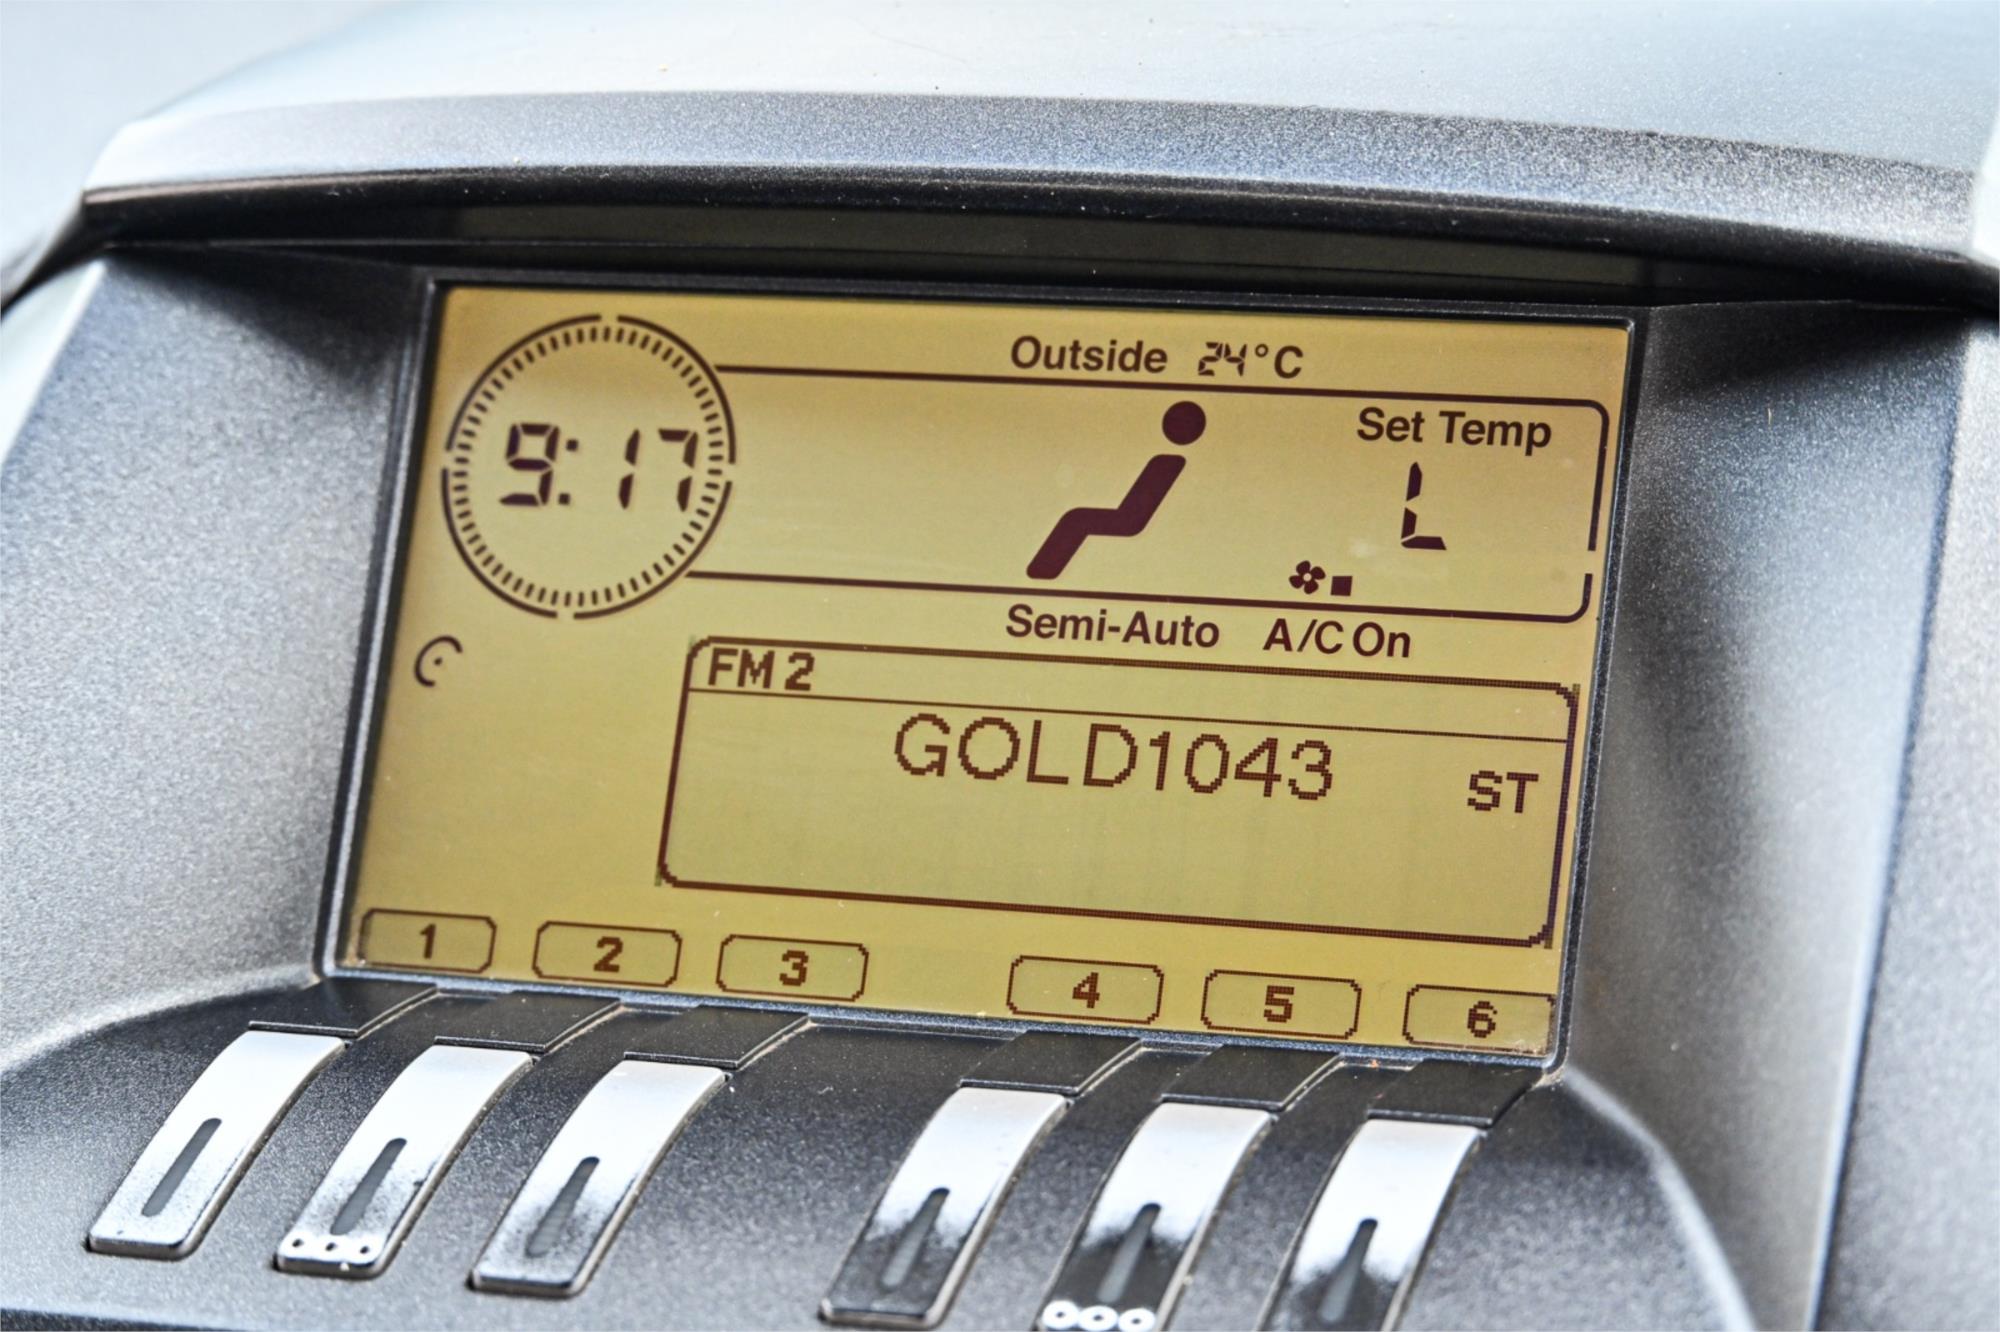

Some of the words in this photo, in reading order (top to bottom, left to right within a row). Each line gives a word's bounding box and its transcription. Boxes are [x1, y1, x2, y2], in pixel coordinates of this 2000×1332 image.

[1011, 336, 1168, 373] Outside
[1357, 407, 1424, 443] Set
[1439, 411, 1552, 456] Temp
[500, 423, 698, 512] 9:17
[1401, 462, 1447, 551] L
[1006, 605, 1221, 648] Semi-Auto
[1263, 619, 1343, 654] A/C
[1353, 622, 1411, 658] On
[895, 713, 1333, 800] GOLD1043
[1468, 771, 1539, 813] ST
[419, 924, 437, 959] 1
[593, 936, 624, 973] 2
[780, 950, 809, 986] 3
[1072, 972, 1101, 1008] 4
[1263, 985, 1295, 1023] 5
[1467, 1001, 1499, 1038] 6
